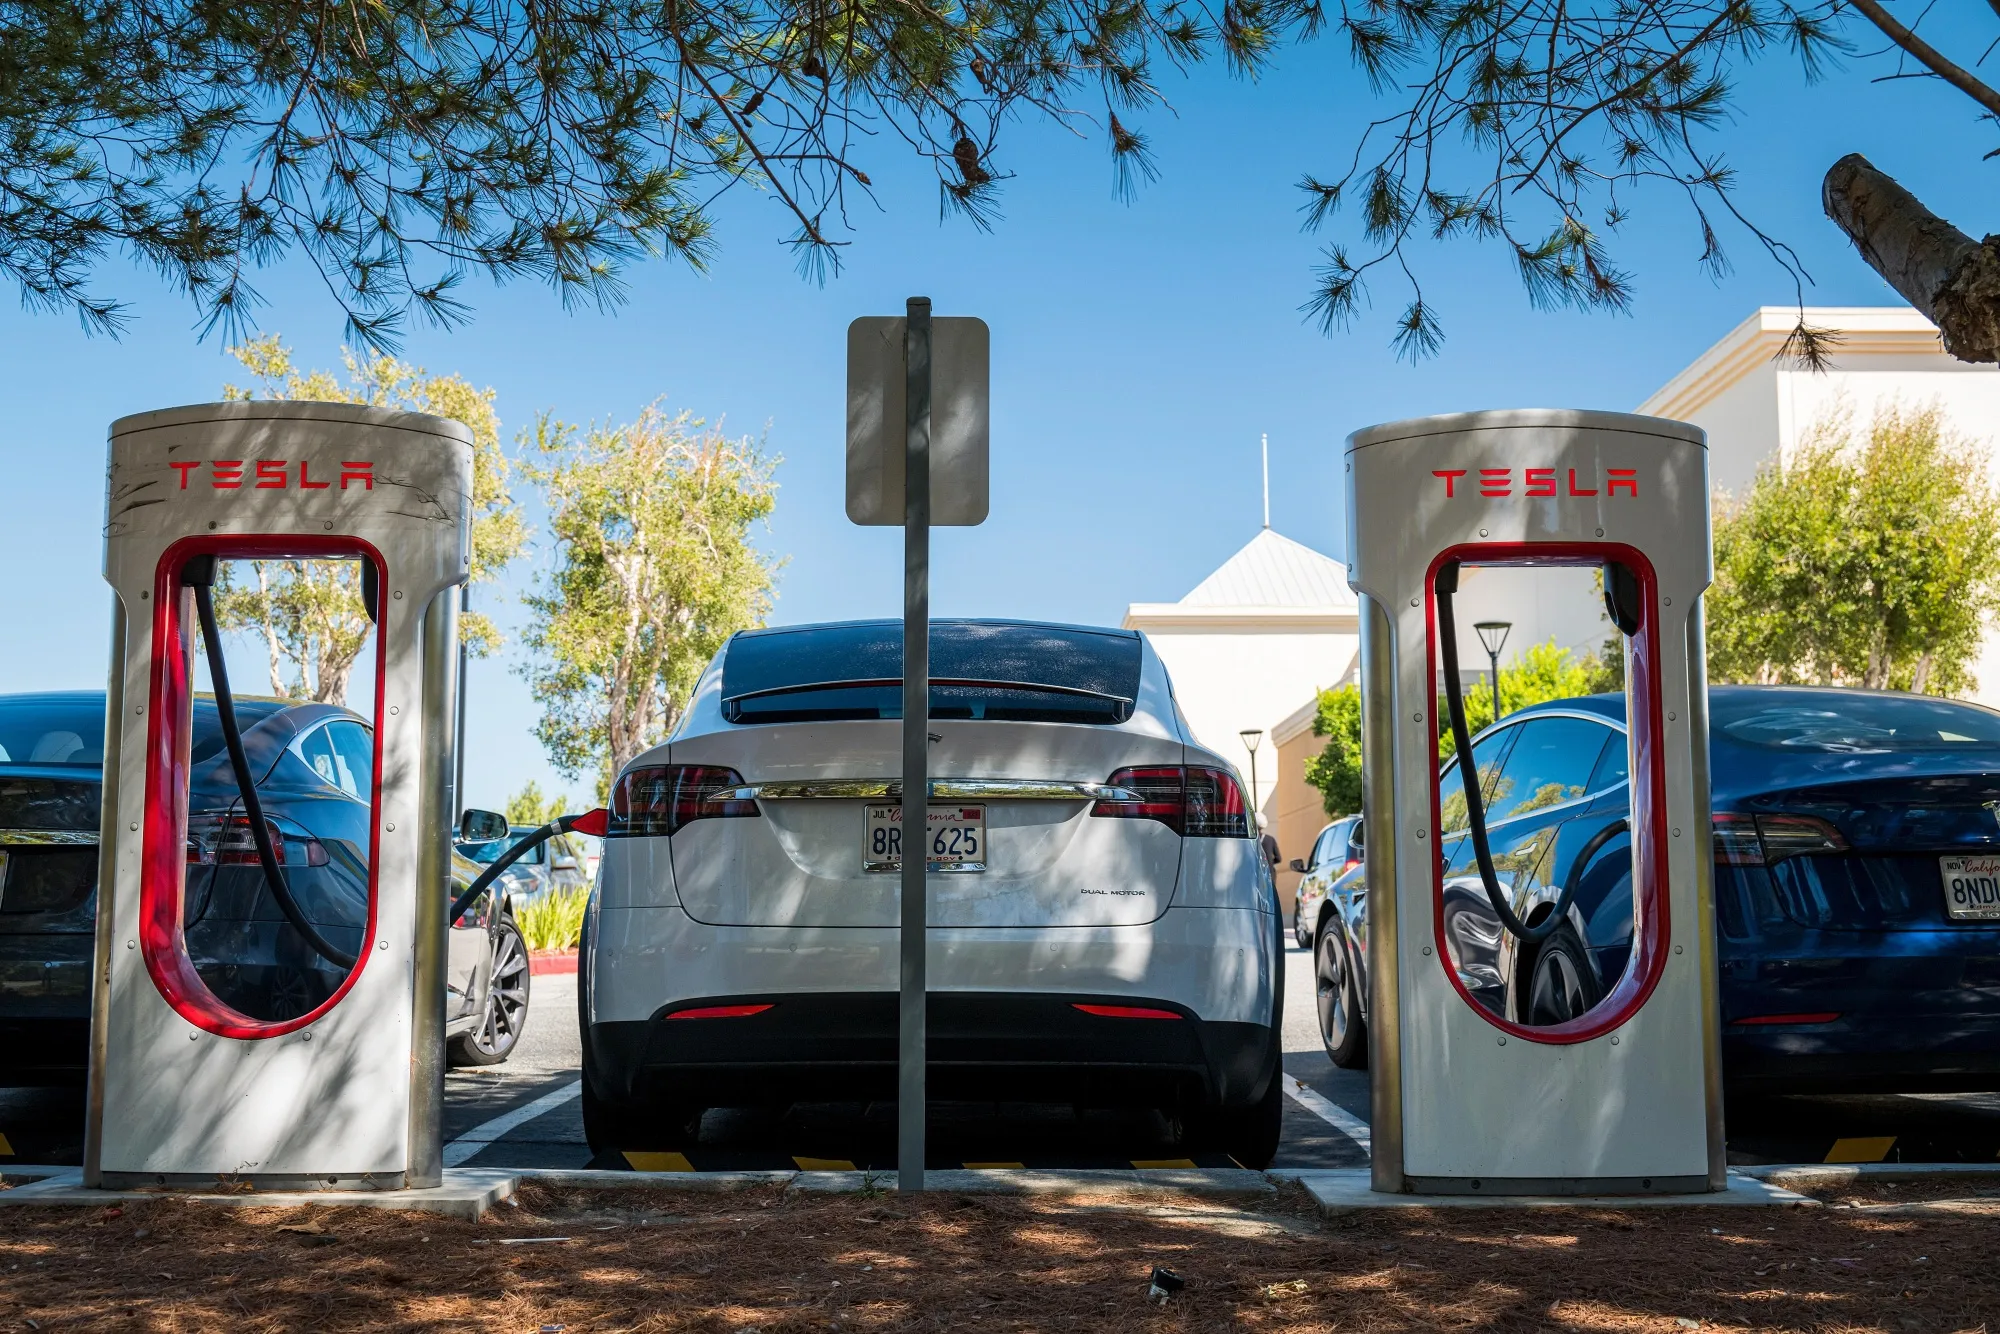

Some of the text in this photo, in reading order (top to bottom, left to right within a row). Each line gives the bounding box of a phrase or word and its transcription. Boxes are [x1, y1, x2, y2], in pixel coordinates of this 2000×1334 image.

[168, 460, 374, 490] TESLA
[1431, 468, 1638, 498] TESLA
[873, 810, 887, 819] JUL
[873, 827, 978, 855] 8R625
[1946, 862, 1961, 870] NOV
